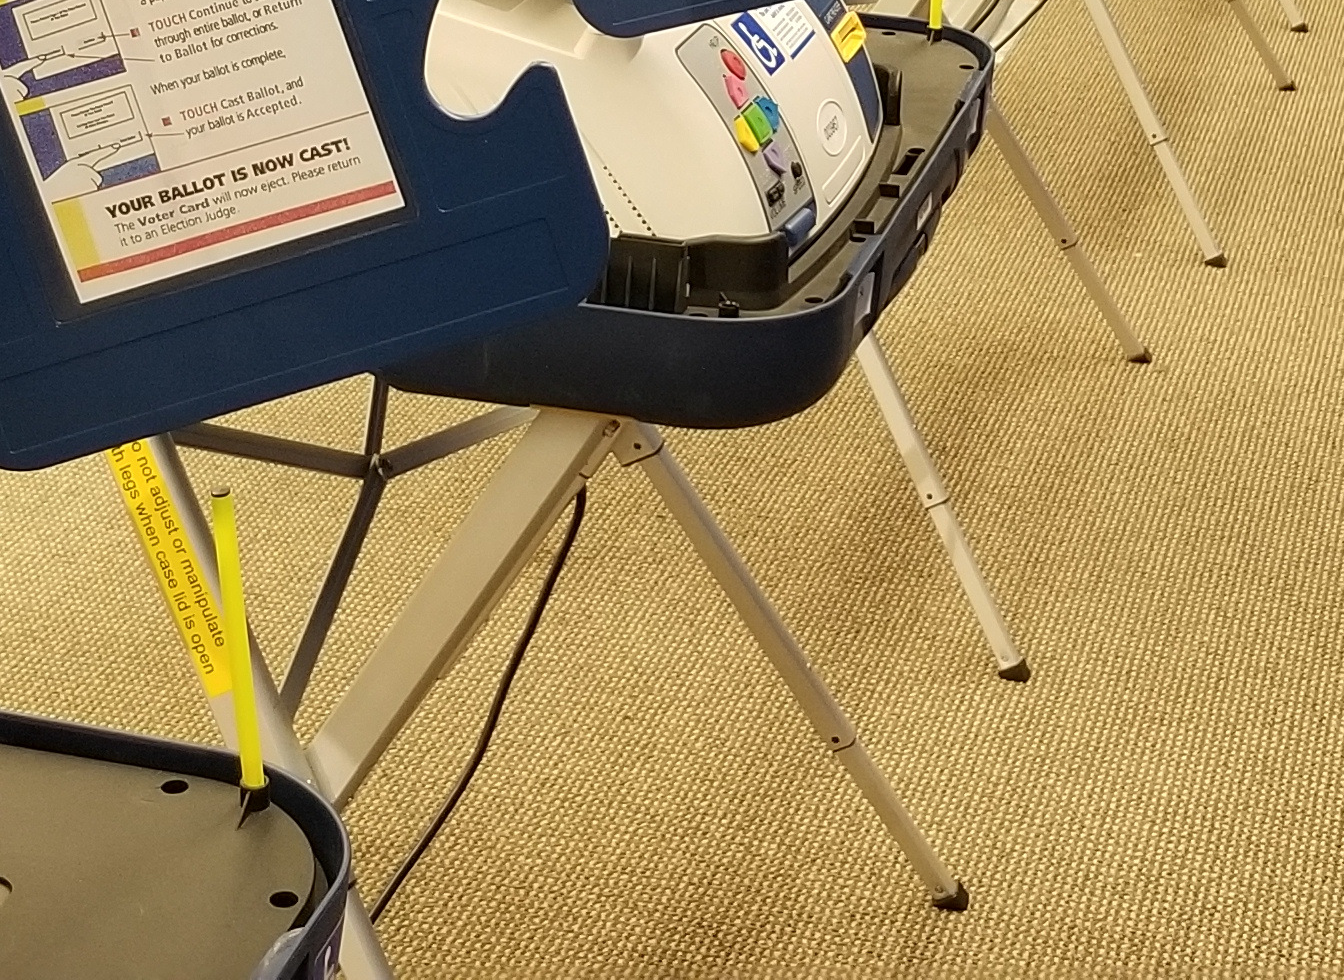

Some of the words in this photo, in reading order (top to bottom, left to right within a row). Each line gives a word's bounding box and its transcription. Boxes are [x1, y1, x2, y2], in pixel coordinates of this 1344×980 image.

[147, 12, 188, 32] TOUCH
[188, 0, 239, 20] Continue
[153, 27, 192, 48] through
[192, 21, 221, 37] entire
[219, 11, 252, 28] ballot,
[252, 8, 263, 19] or
[159, 53, 173, 64] to
[173, 41, 209, 59] Ballot
[209, 36, 224, 49] for
[226, 21, 279, 44] corrections.
[149, 80, 180, 95] When
[179, 73, 201, 90] your
[201, 64, 231, 80] ballot
[230, 61, 240, 72] is
[240, 49, 286, 69] complete,
[179, 101, 219, 121] TOUCH
[220, 94, 246, 110] Cast
[246, 84, 285, 102] Ballot,
[285, 75, 304, 91] and
[185, 123, 206, 140] your
[206, 114, 236, 131] ballot
[236, 112, 245, 122] is
[246, 94, 302, 120] Accepted.
[104, 194, 156, 219] YOUR
[157, 172, 226, 205] BALLOT
[230, 166, 249, 183] IS
[251, 152, 294, 177] NOW
[299, 137, 351, 163] CAST!
[113, 221, 136, 234] The
[136, 209, 175, 227] Voter
[178, 197, 211, 215] Card
[211, 190, 232, 205] will
[233, 185, 258, 199] now
[260, 176, 290, 193] eject.
[291, 166, 326, 183] Please
[327, 156, 361, 173] return
[120, 237, 129, 247] it
[129, 234, 143, 245] to
[144, 229, 159, 240] an
[159, 216, 203, 235] Election
[204, 206, 239, 223] Judge.
[119, 463, 140, 500] legs
[134, 501, 161, 547] when
[156, 550, 178, 590] case
[173, 591, 190, 613] lid
[183, 614, 196, 630] is
[191, 633, 215, 675] open
[136, 455, 158, 484] not
[149, 486, 179, 536] adjust
[172, 536, 187, 555] or
[181, 558, 225, 648] manipulate
